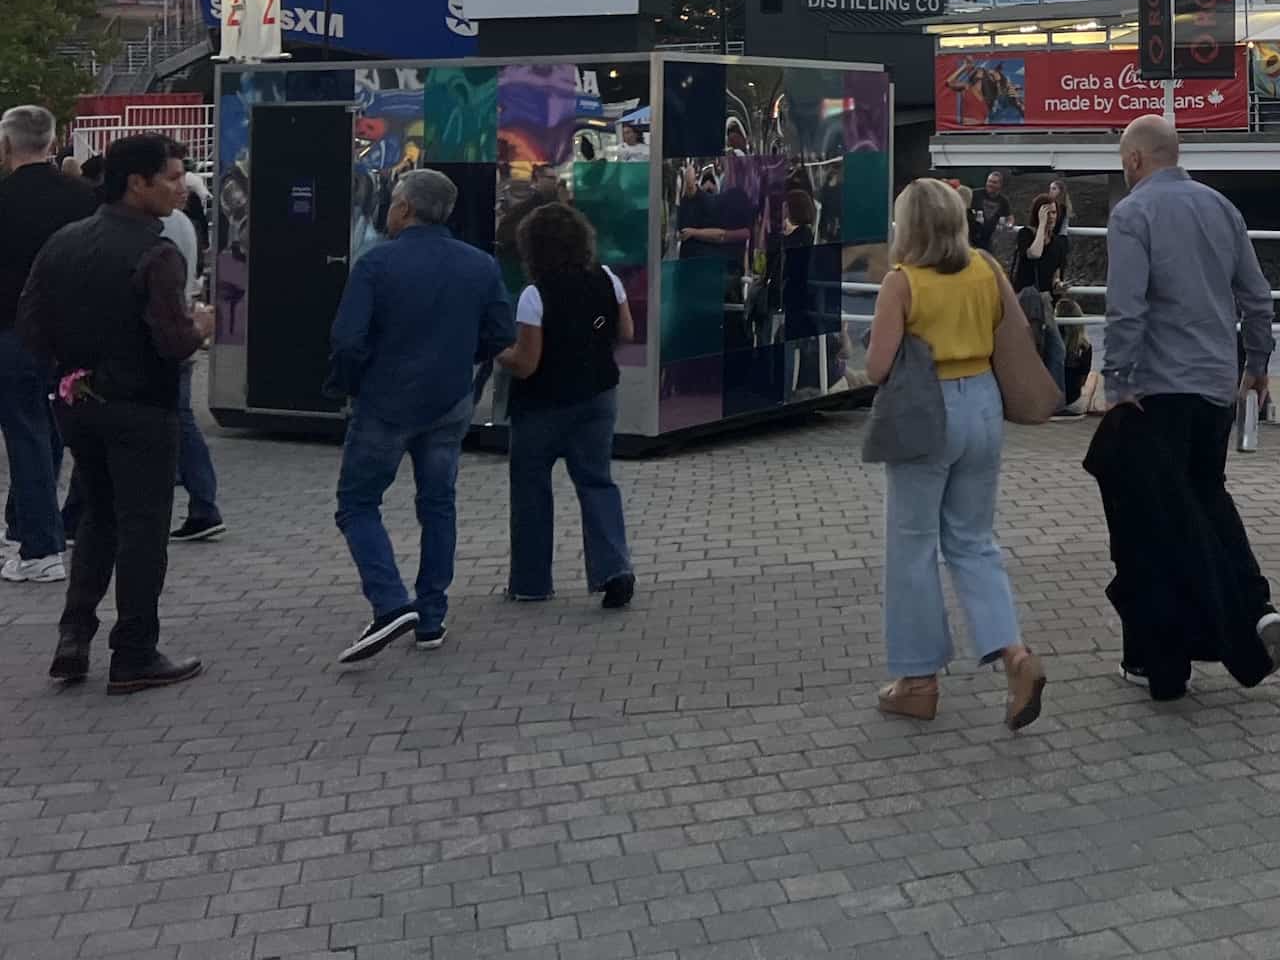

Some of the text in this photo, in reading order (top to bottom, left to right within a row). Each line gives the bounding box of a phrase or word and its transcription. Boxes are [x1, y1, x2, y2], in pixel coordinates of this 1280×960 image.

[1061, 75, 1100, 90] Grab
[1104, 77, 1114, 89] a
[1045, 94, 1204, 113] made by Canadans
